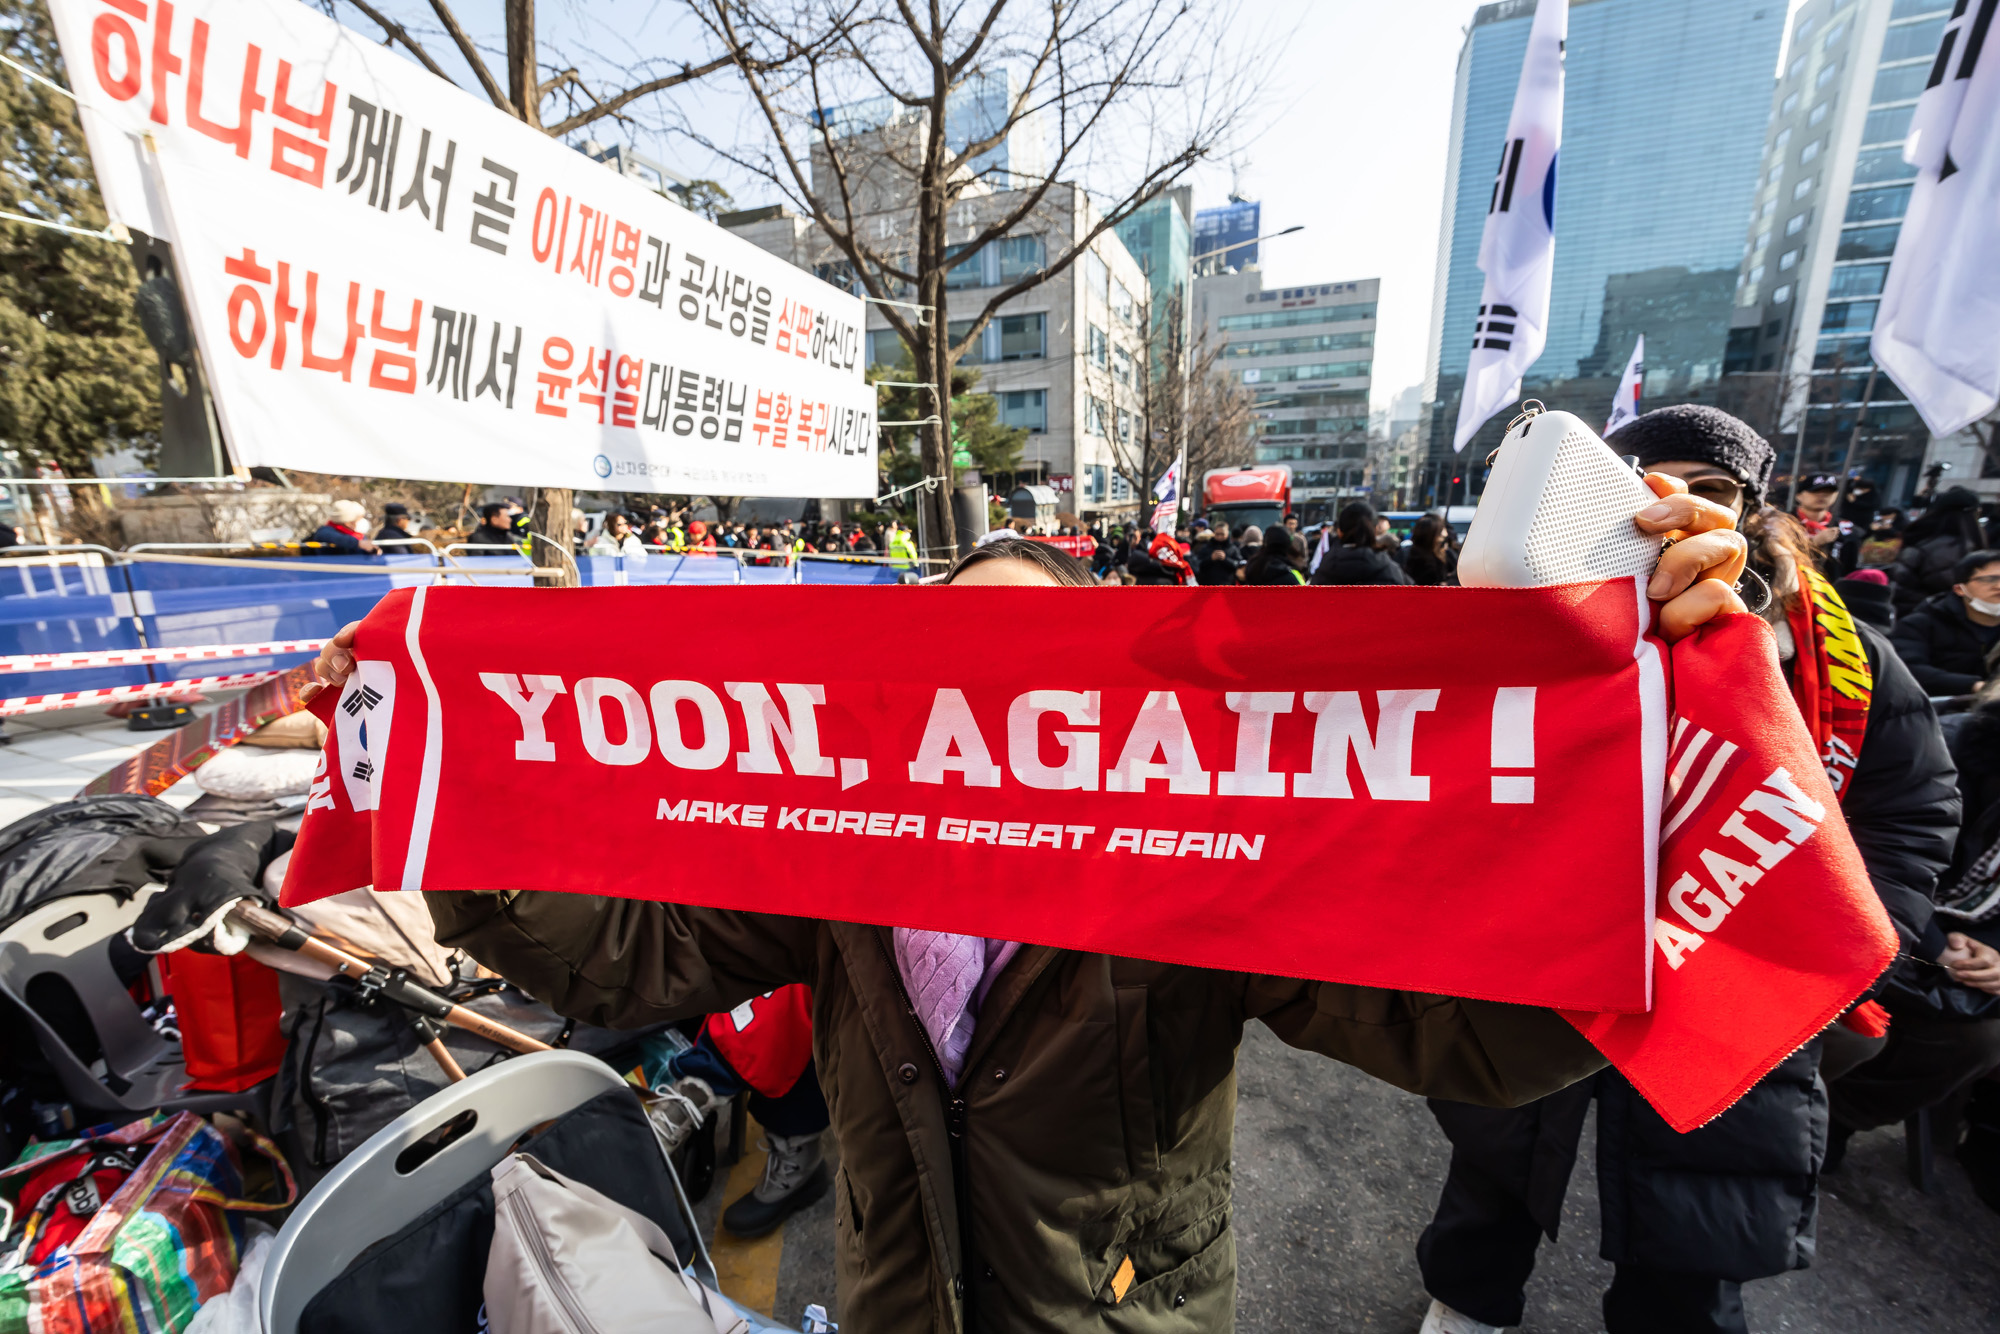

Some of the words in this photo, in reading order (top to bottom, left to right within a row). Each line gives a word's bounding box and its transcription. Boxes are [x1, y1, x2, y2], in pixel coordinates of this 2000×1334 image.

[91, 0, 456, 232] 하나님께서
[470, 156, 518, 256] 곧
[532, 186, 671, 309] 이재명과
[679, 252, 772, 346] 공산당을
[776, 297, 858, 374] 심판하신다
[225, 247, 522, 409] 하나님께서
[535, 336, 747, 443] 윤석열대통령님
[752, 388, 793, 449] 부활
[797, 399, 871, 457] 복귀시킨다
[478, 671, 869, 791] YOON,
[908, 687, 1441, 802] AGAIN
[1491, 686, 1538, 804] !
[655, 798, 766, 829] MAKE
[776, 807, 926, 839] KOREA
[937, 817, 1096, 850] GREAT
[1105, 828, 1266, 861] AGAIN
[1654, 766, 1827, 971] AGAIN
